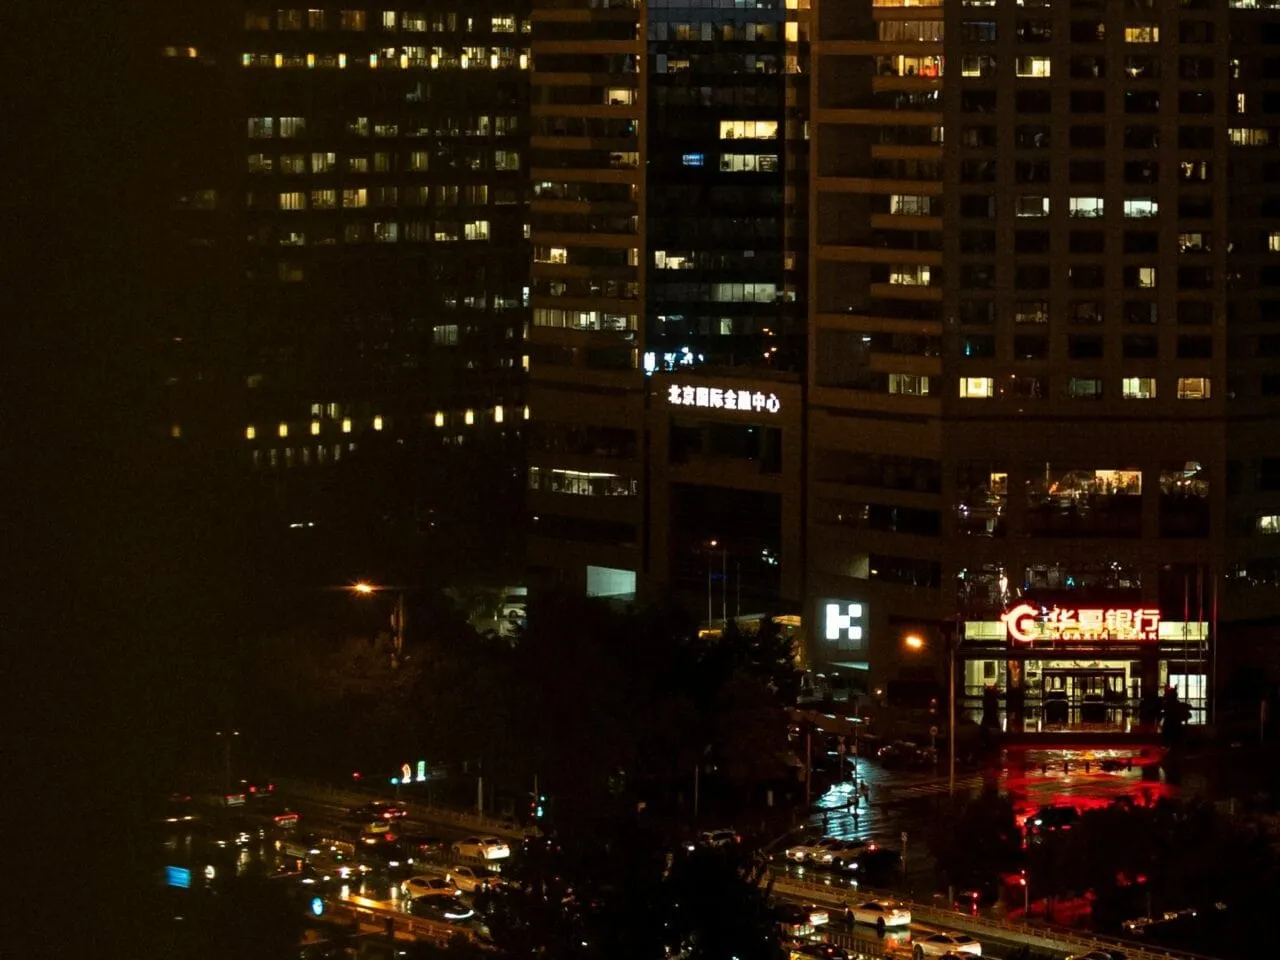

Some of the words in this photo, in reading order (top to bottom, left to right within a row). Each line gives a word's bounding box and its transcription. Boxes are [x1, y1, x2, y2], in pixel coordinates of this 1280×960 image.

[668, 384, 781, 413] 北京国际金融中心
[1048, 608, 1161, 632] 华夏银行
